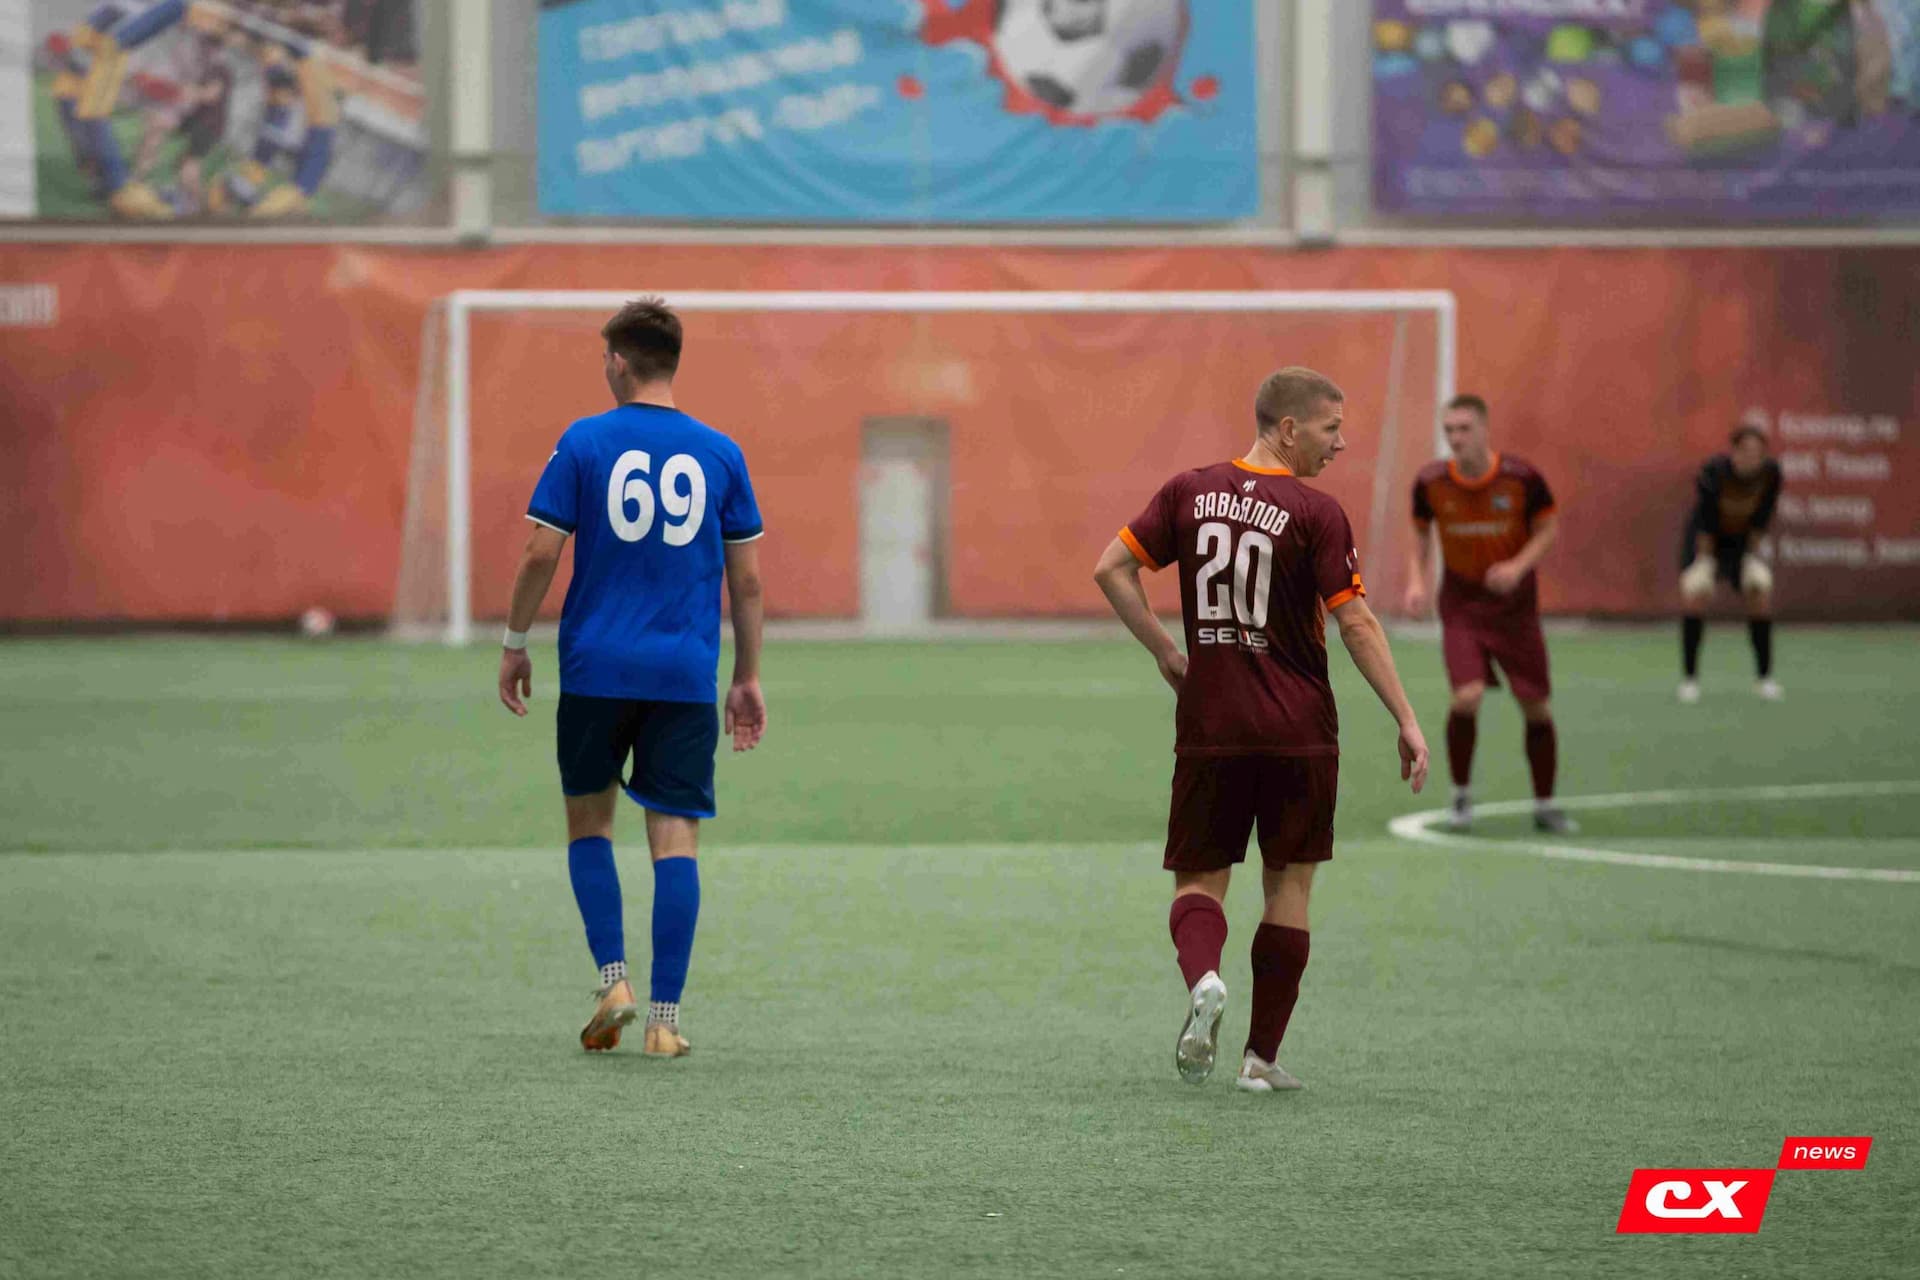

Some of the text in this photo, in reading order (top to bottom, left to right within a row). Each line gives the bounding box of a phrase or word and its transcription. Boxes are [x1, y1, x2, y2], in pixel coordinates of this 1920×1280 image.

[608, 449, 707, 547] 69
[1194, 491, 1290, 536] ЗАВЬЯЛОВ
[1195, 522, 1274, 627] 20
